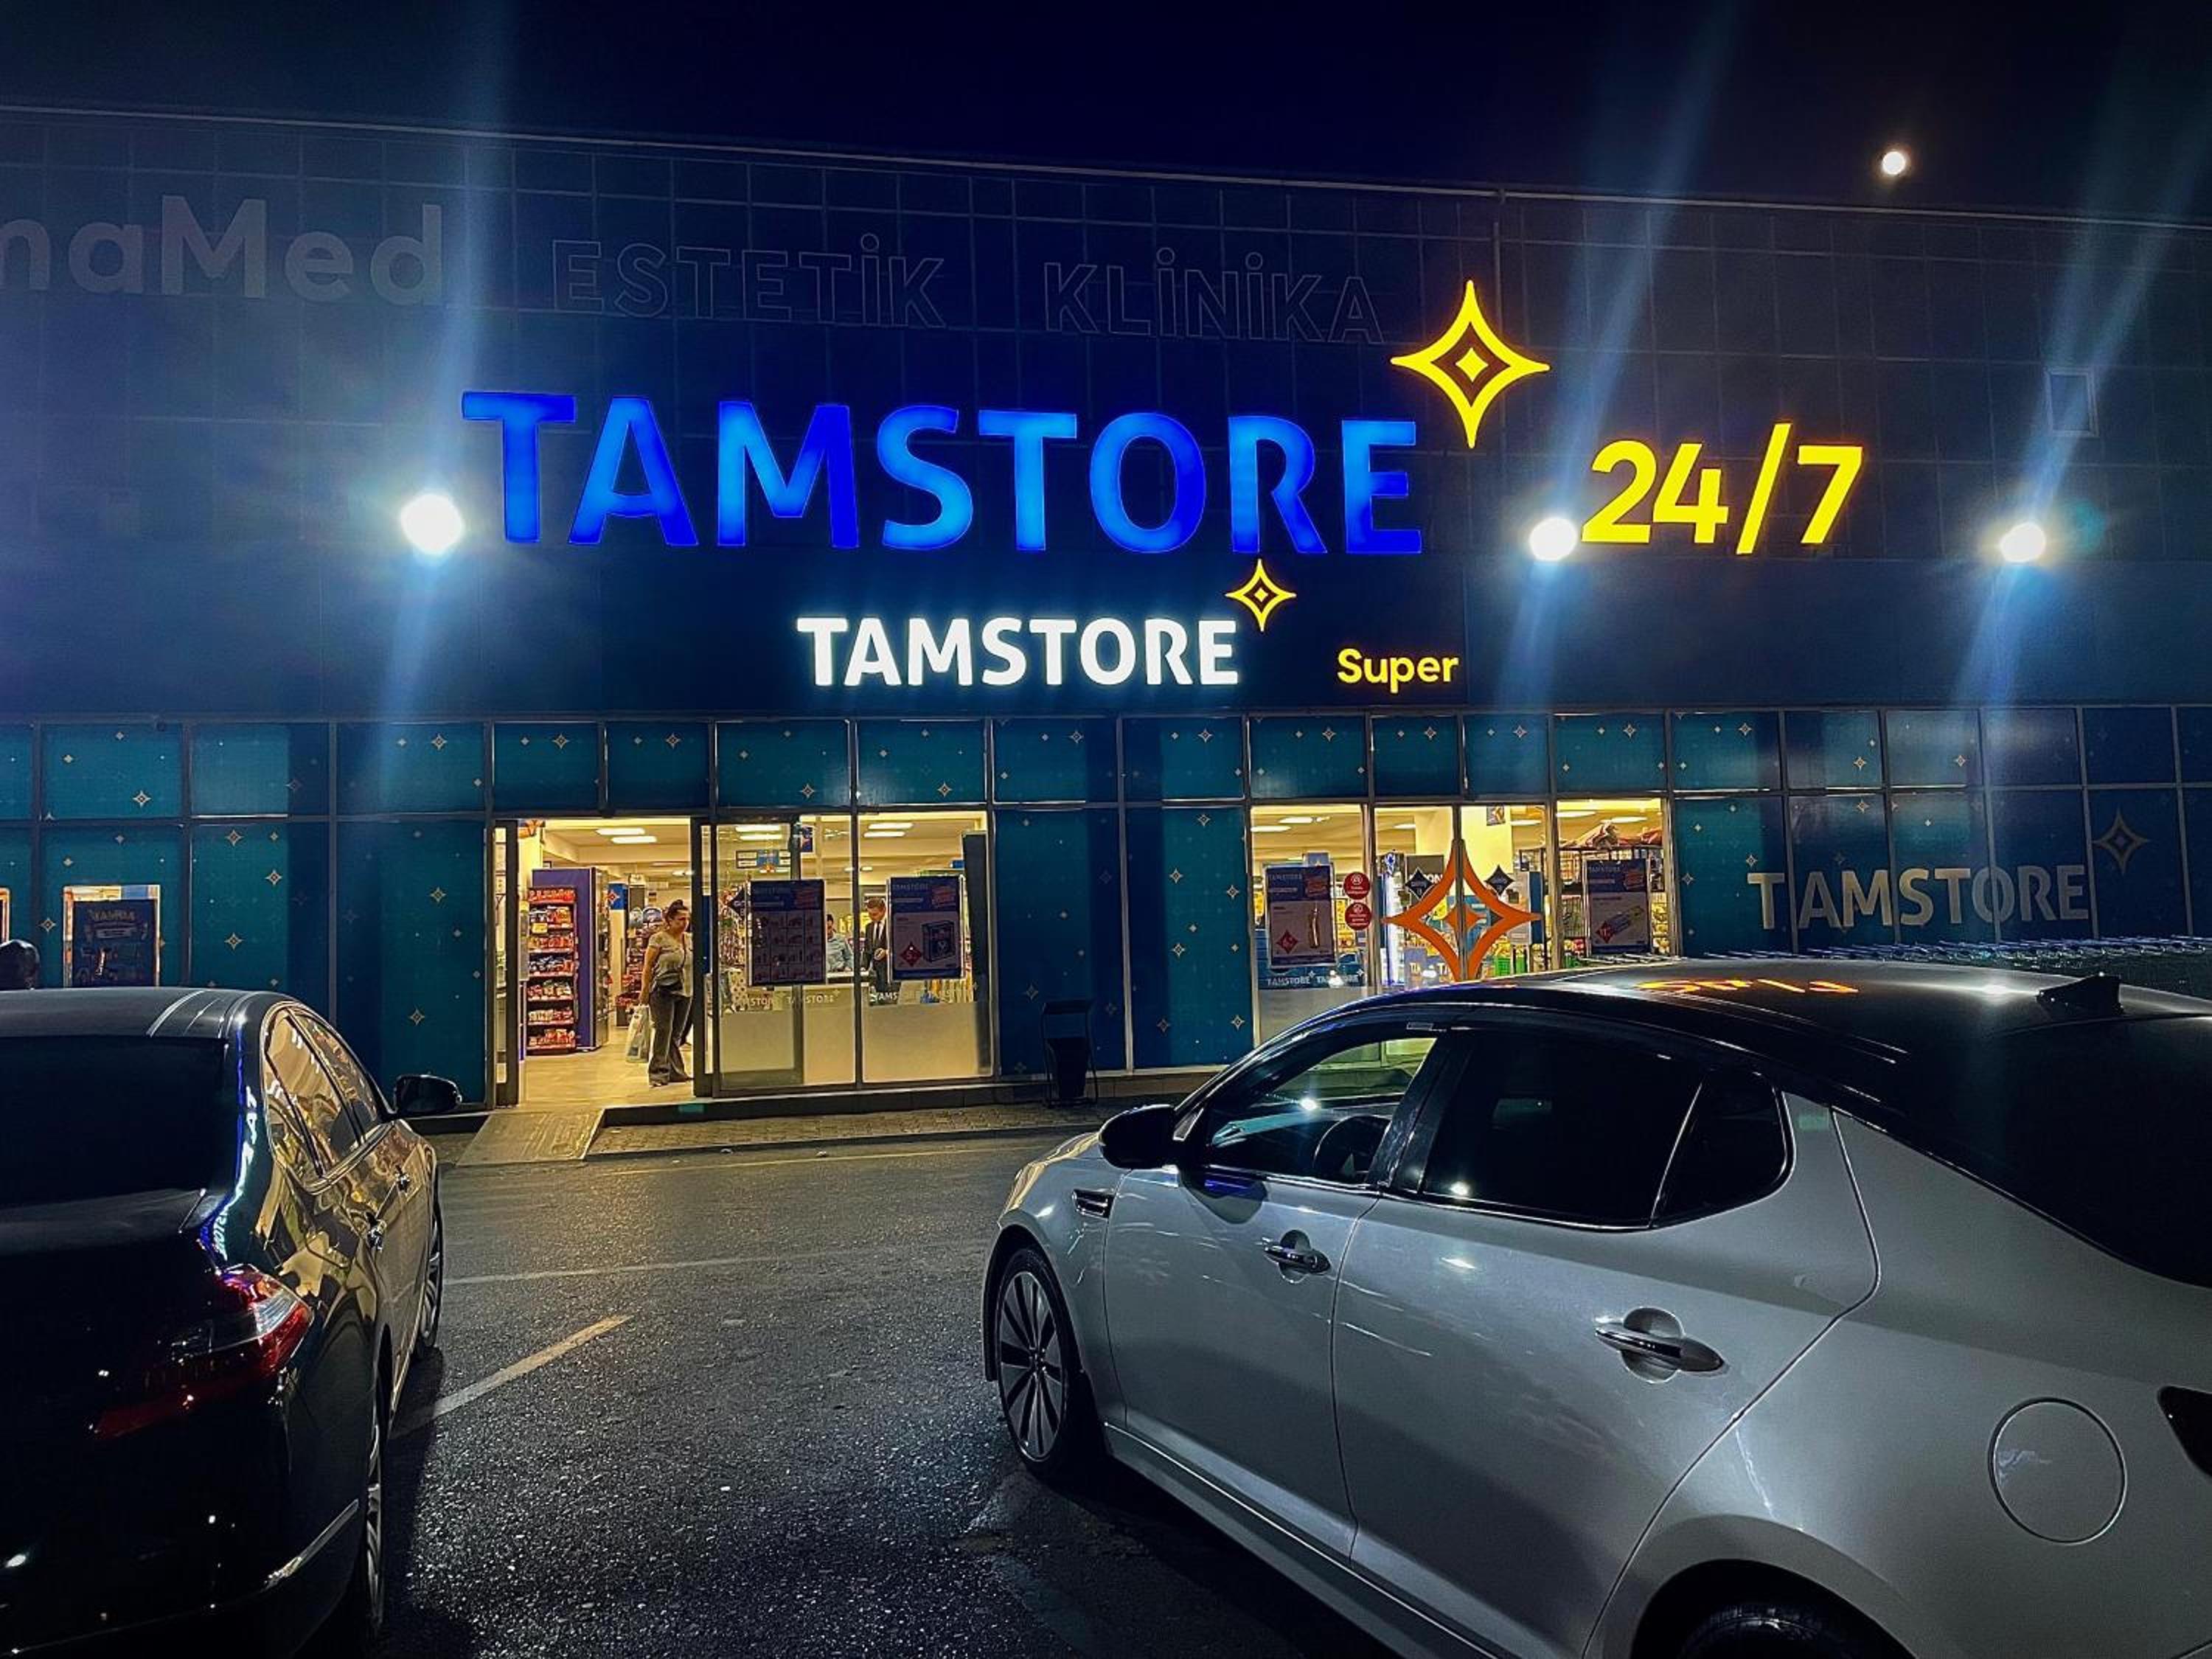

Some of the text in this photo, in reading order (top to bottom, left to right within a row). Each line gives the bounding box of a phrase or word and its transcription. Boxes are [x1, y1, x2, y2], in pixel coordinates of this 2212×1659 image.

[552, 232, 1385, 344] ESTETİK KLİNİKA
[462, 391, 1423, 554] TAMSTORE
[1581, 422, 1863, 554] 24/7
[796, 617, 1240, 687] TAMSTORE
[1336, 647, 1460, 694] Super
[1747, 864, 2090, 931] TAMSTORE
